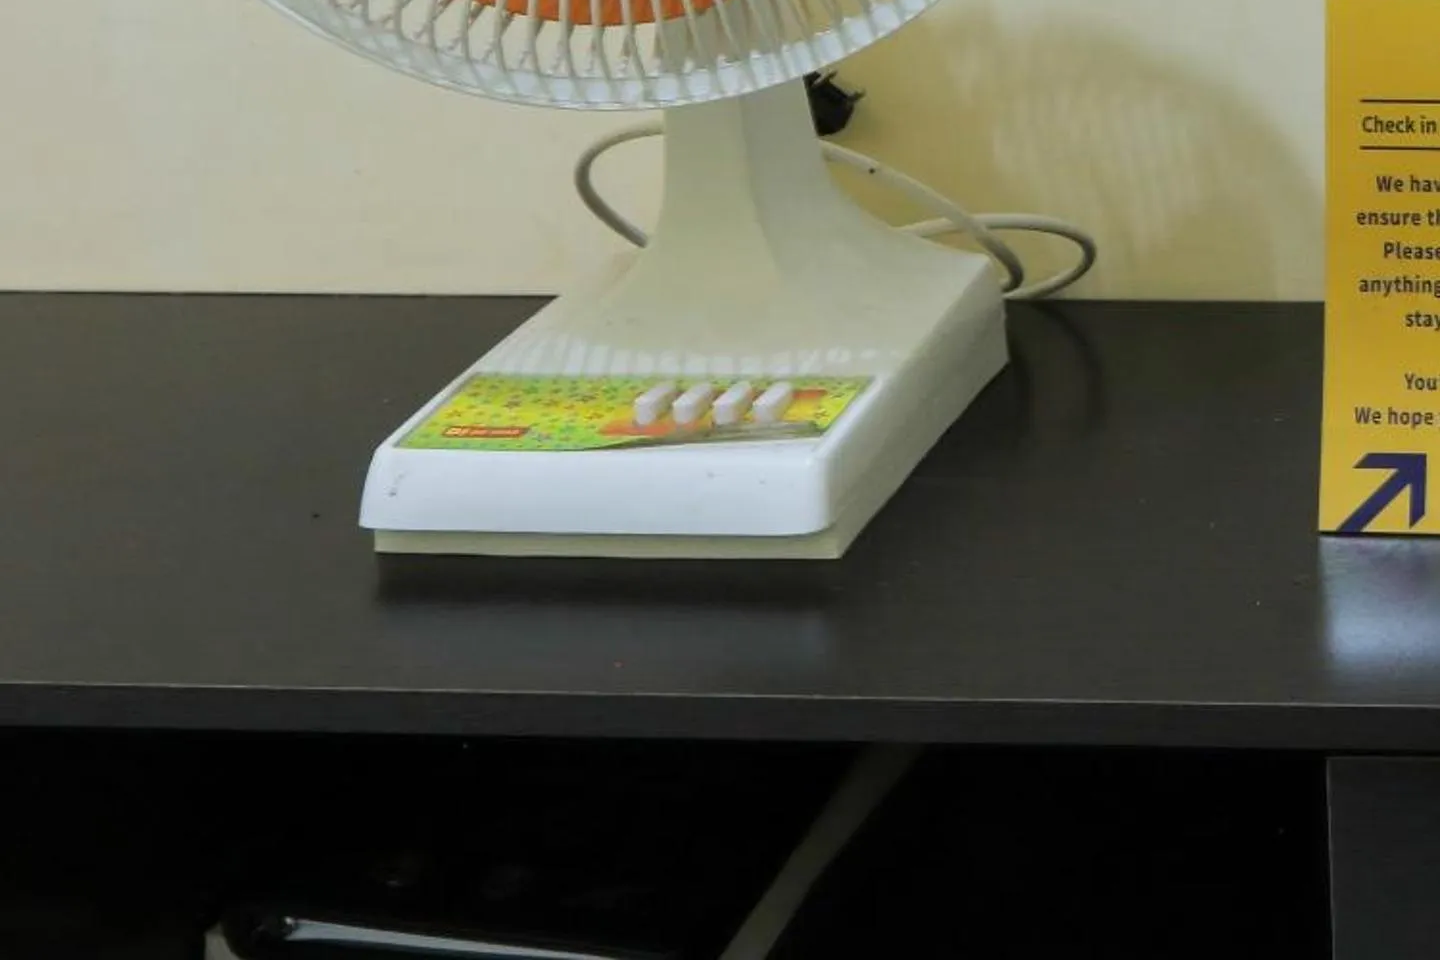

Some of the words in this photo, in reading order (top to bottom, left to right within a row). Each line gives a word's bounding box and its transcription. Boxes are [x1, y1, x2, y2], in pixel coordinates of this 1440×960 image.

[1361, 114, 1417, 134] Check
[1419, 115, 1438, 135] in
[1375, 175, 1405, 193] We
[1356, 211, 1422, 227] ensure
[1354, 406, 1382, 425] We
[1387, 406, 1435, 430] hope
